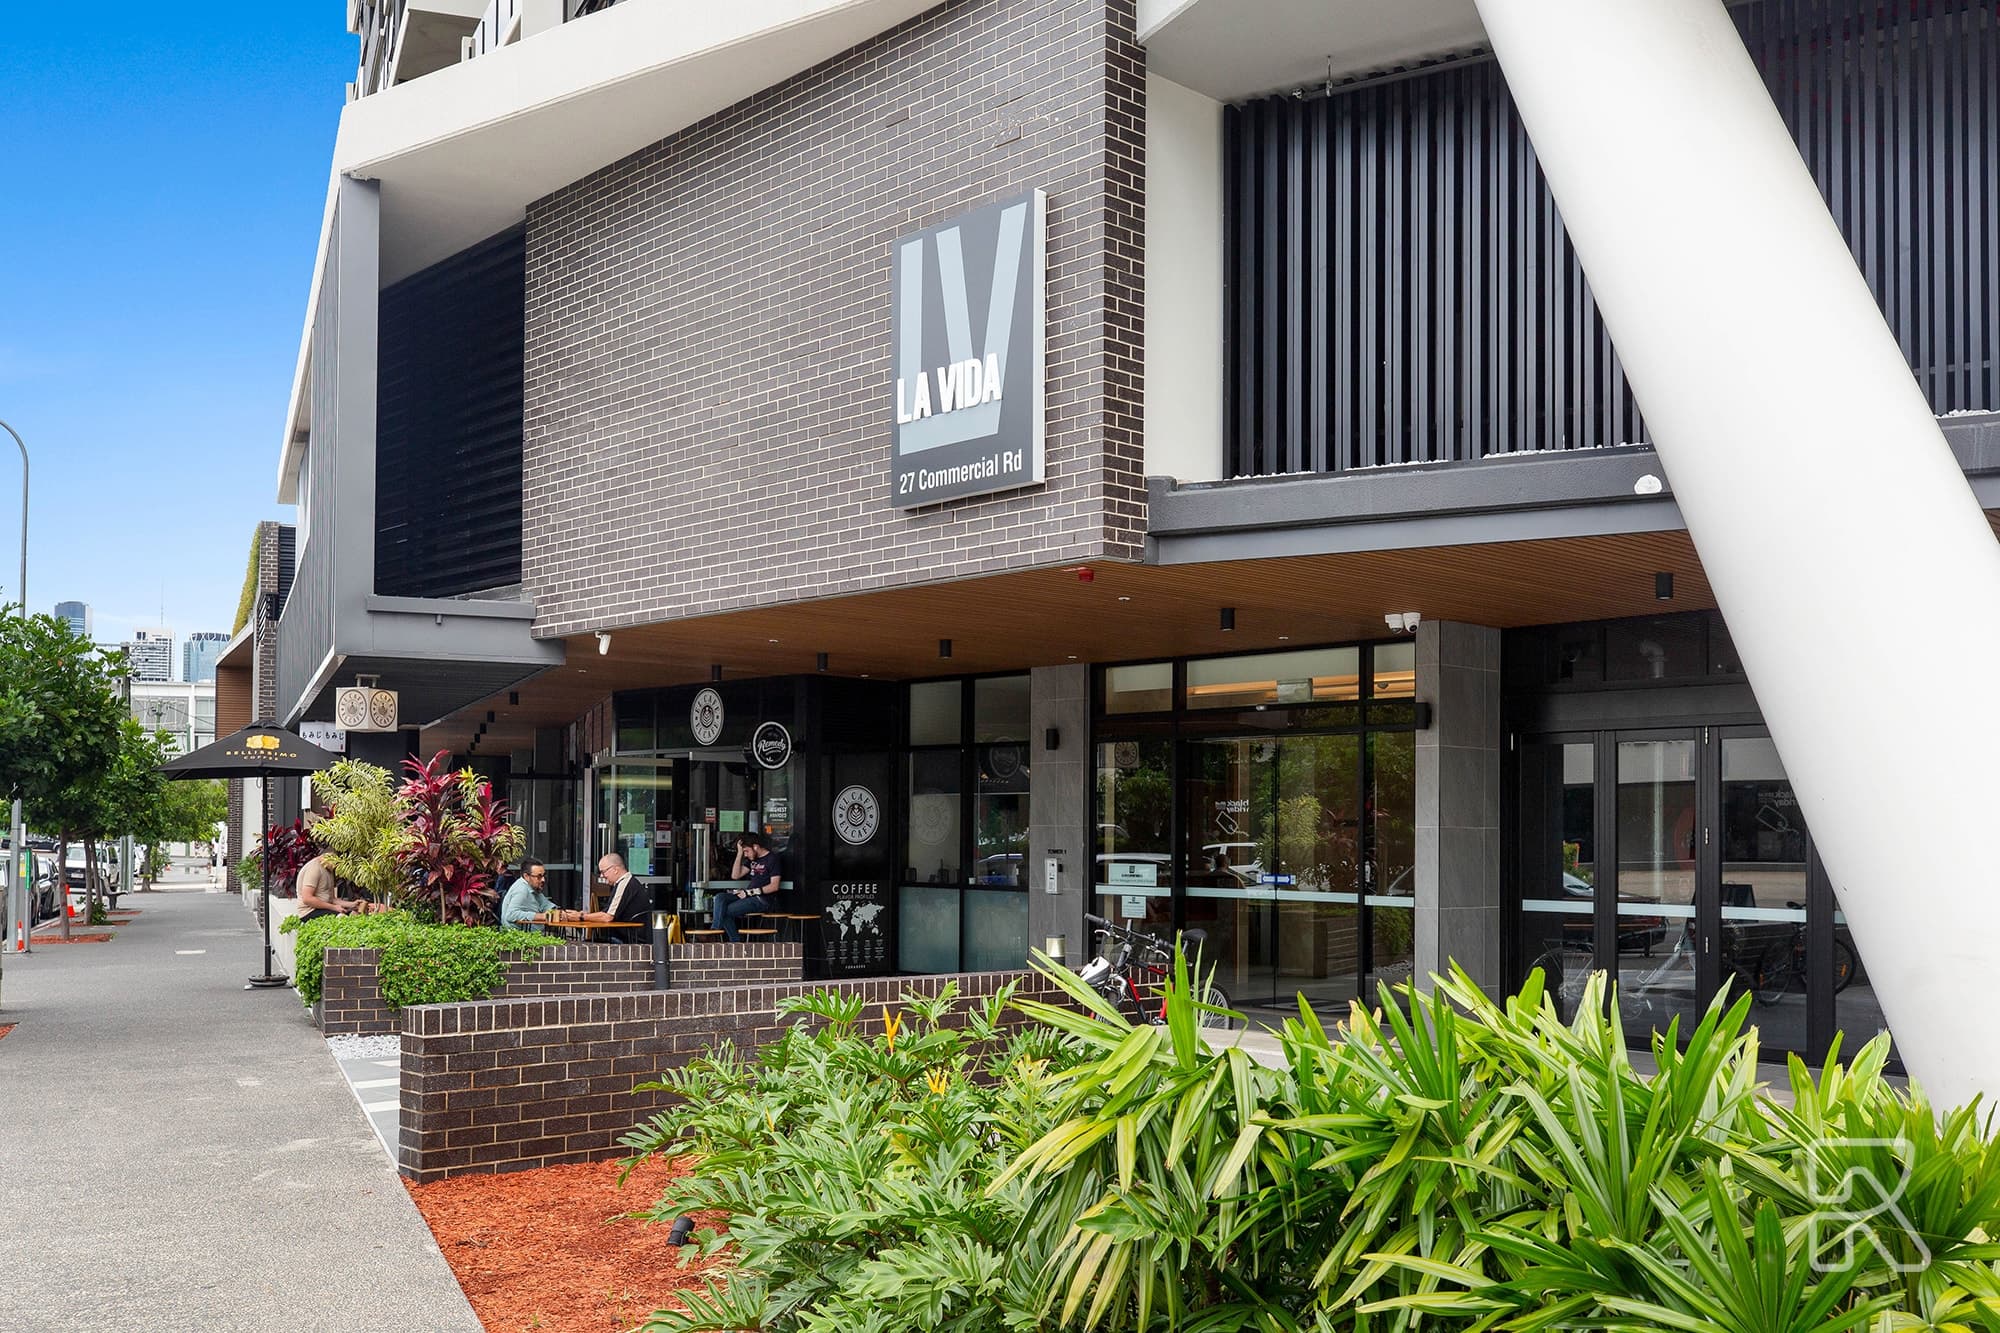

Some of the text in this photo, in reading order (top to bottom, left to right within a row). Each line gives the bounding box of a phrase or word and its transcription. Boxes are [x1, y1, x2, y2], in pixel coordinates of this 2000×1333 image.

[896, 353, 1003, 424] LA VIDA
[899, 449, 1022, 495] 27 Commercial Rd
[757, 738, 786, 755] Remedy
[839, 791, 874, 811] EL CAFE
[839, 820, 873, 838] EL CAFE
[832, 883, 878, 895] COFFEE
